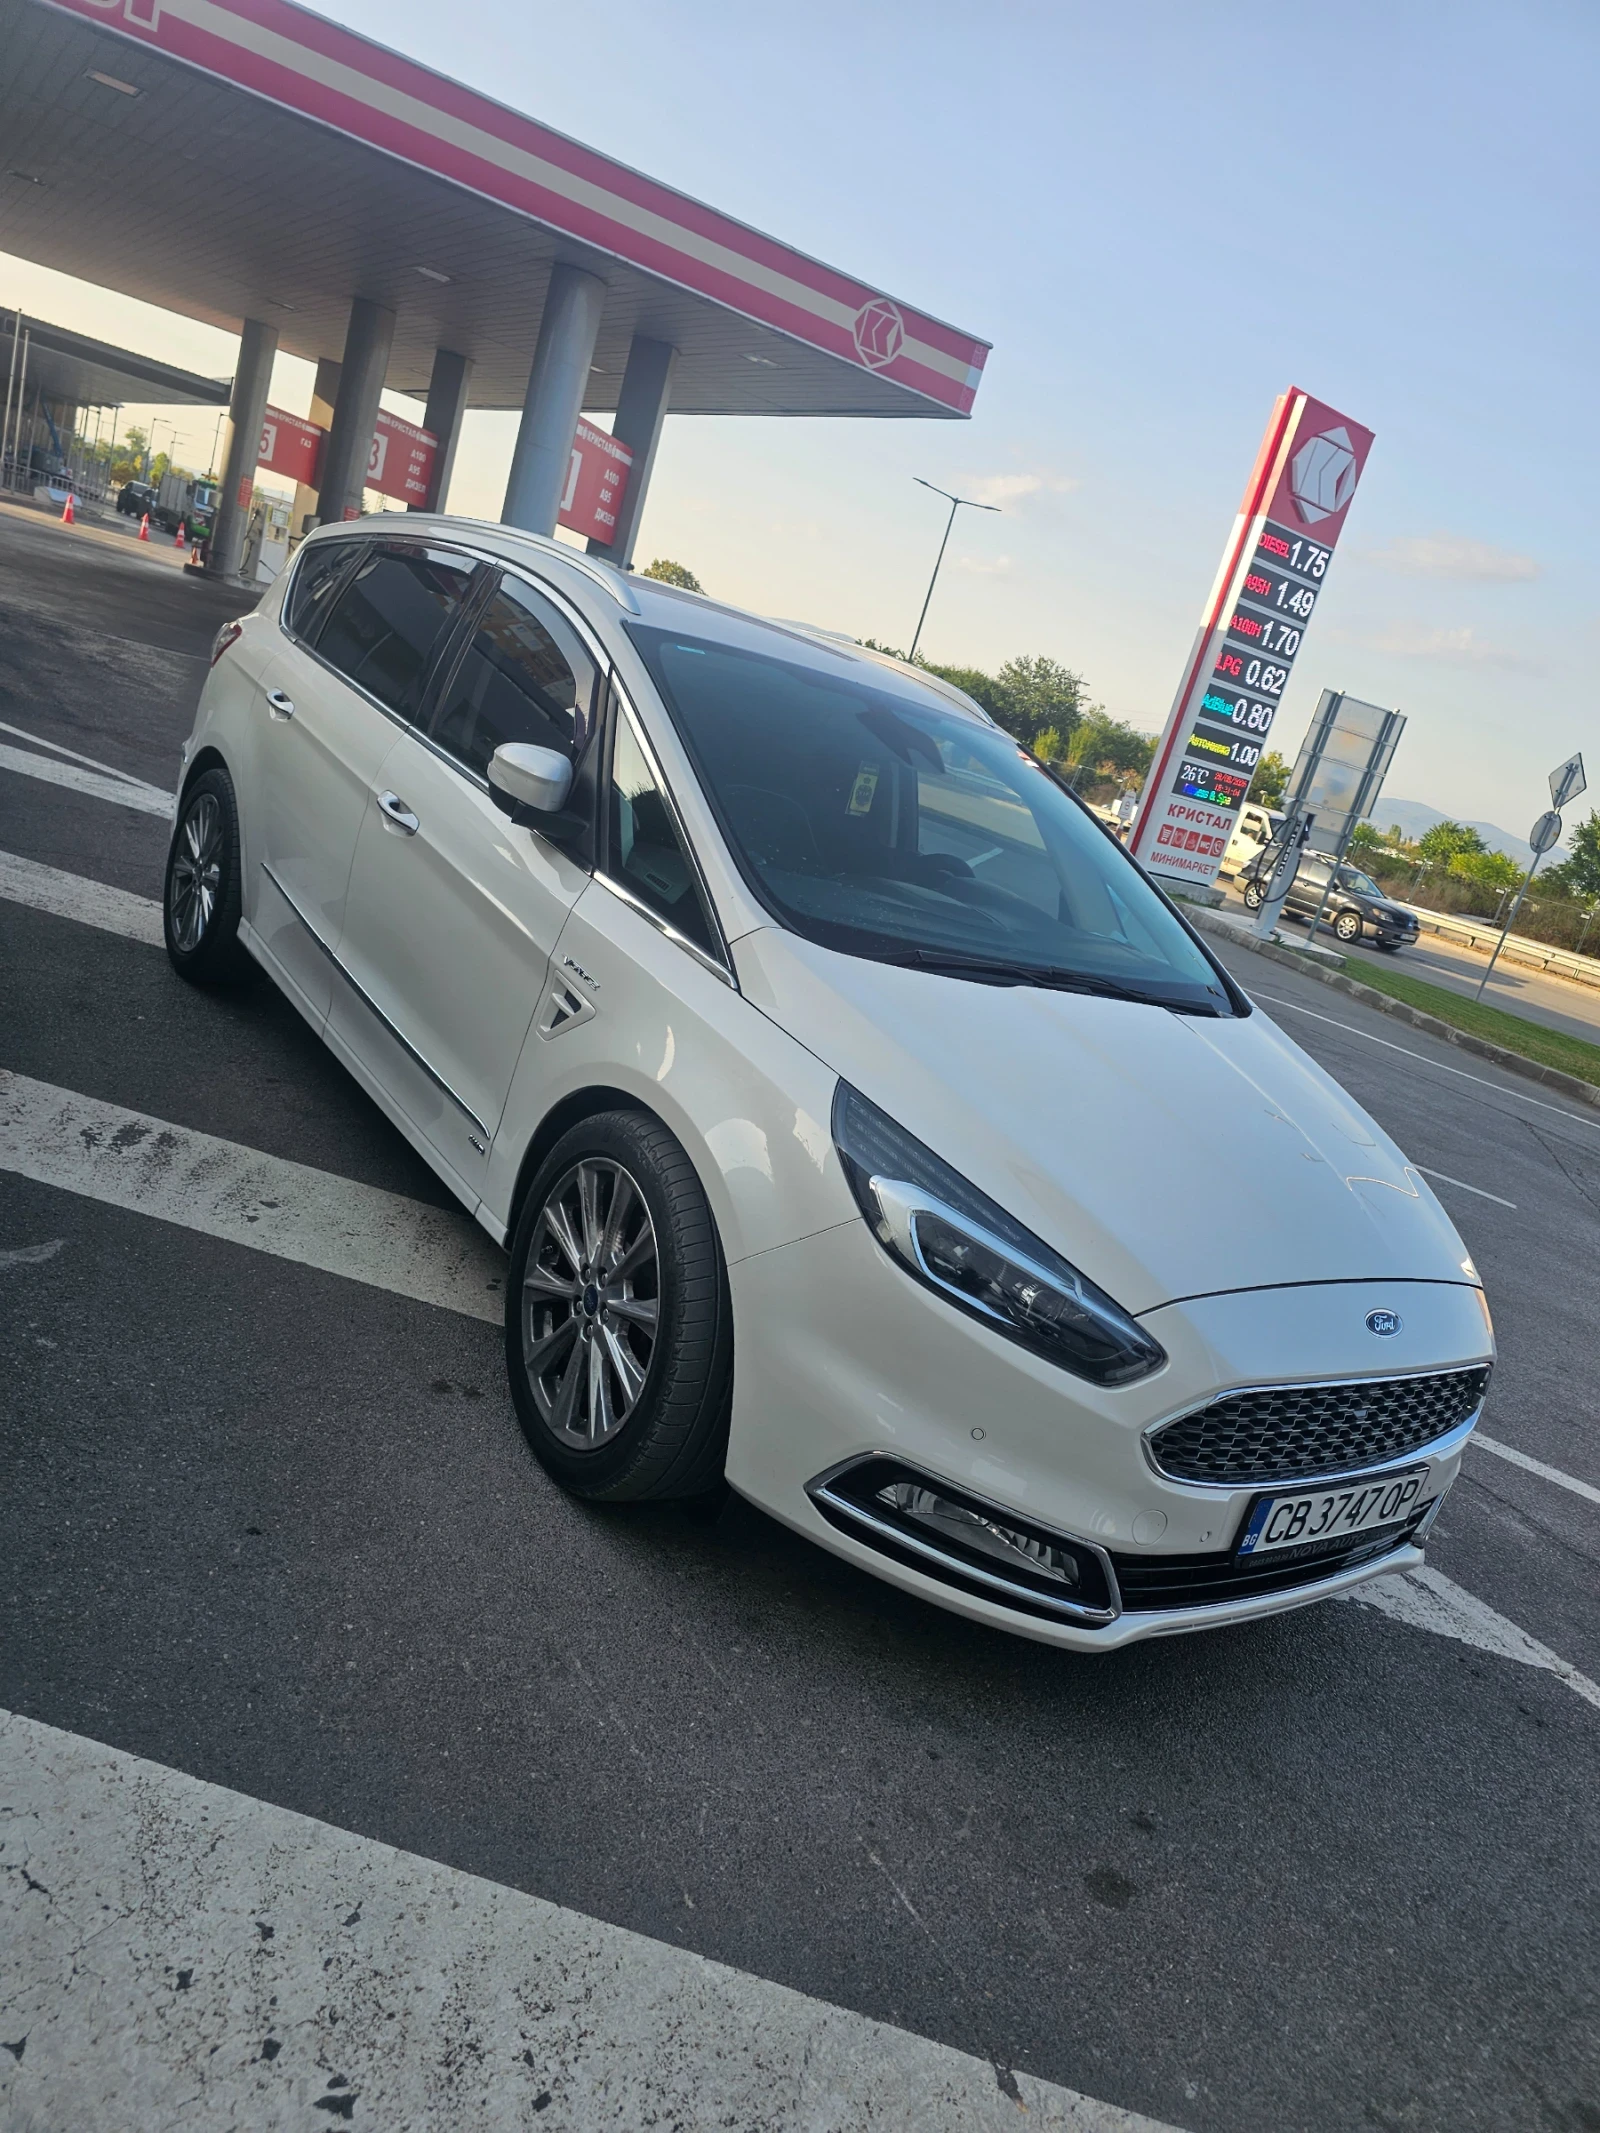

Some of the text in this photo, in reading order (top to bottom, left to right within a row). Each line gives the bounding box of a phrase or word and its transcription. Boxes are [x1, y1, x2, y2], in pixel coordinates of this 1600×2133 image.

[260, 429, 270, 453] 5
[368, 439, 380, 470] 3
[594, 507, 615, 527] ДИЗЕЛ
[1258, 532, 1330, 578] DIESEL 1.75
[1276, 581, 1315, 617] 1.49
[1261, 620, 1300, 656] 1.70
[1215, 651, 1287, 695] LPG 0.62
[1202, 693, 1273, 732] AdBlue 0.80
[1230, 742, 1260, 767] 1.00
[1216, 792, 1232, 806] Spa
[1167, 803, 1232, 831] КРИСТАЛ
[1200, 841, 1210, 850] WC
[1150, 851, 1217, 876] МИНИМАРКЕТ
[1374, 1314, 1395, 1332] Ford
[1242, 1533, 1258, 1547] BG
[1289, 1541, 1328, 1559] NOVA
[1328, 1532, 1367, 1550] AUTO
